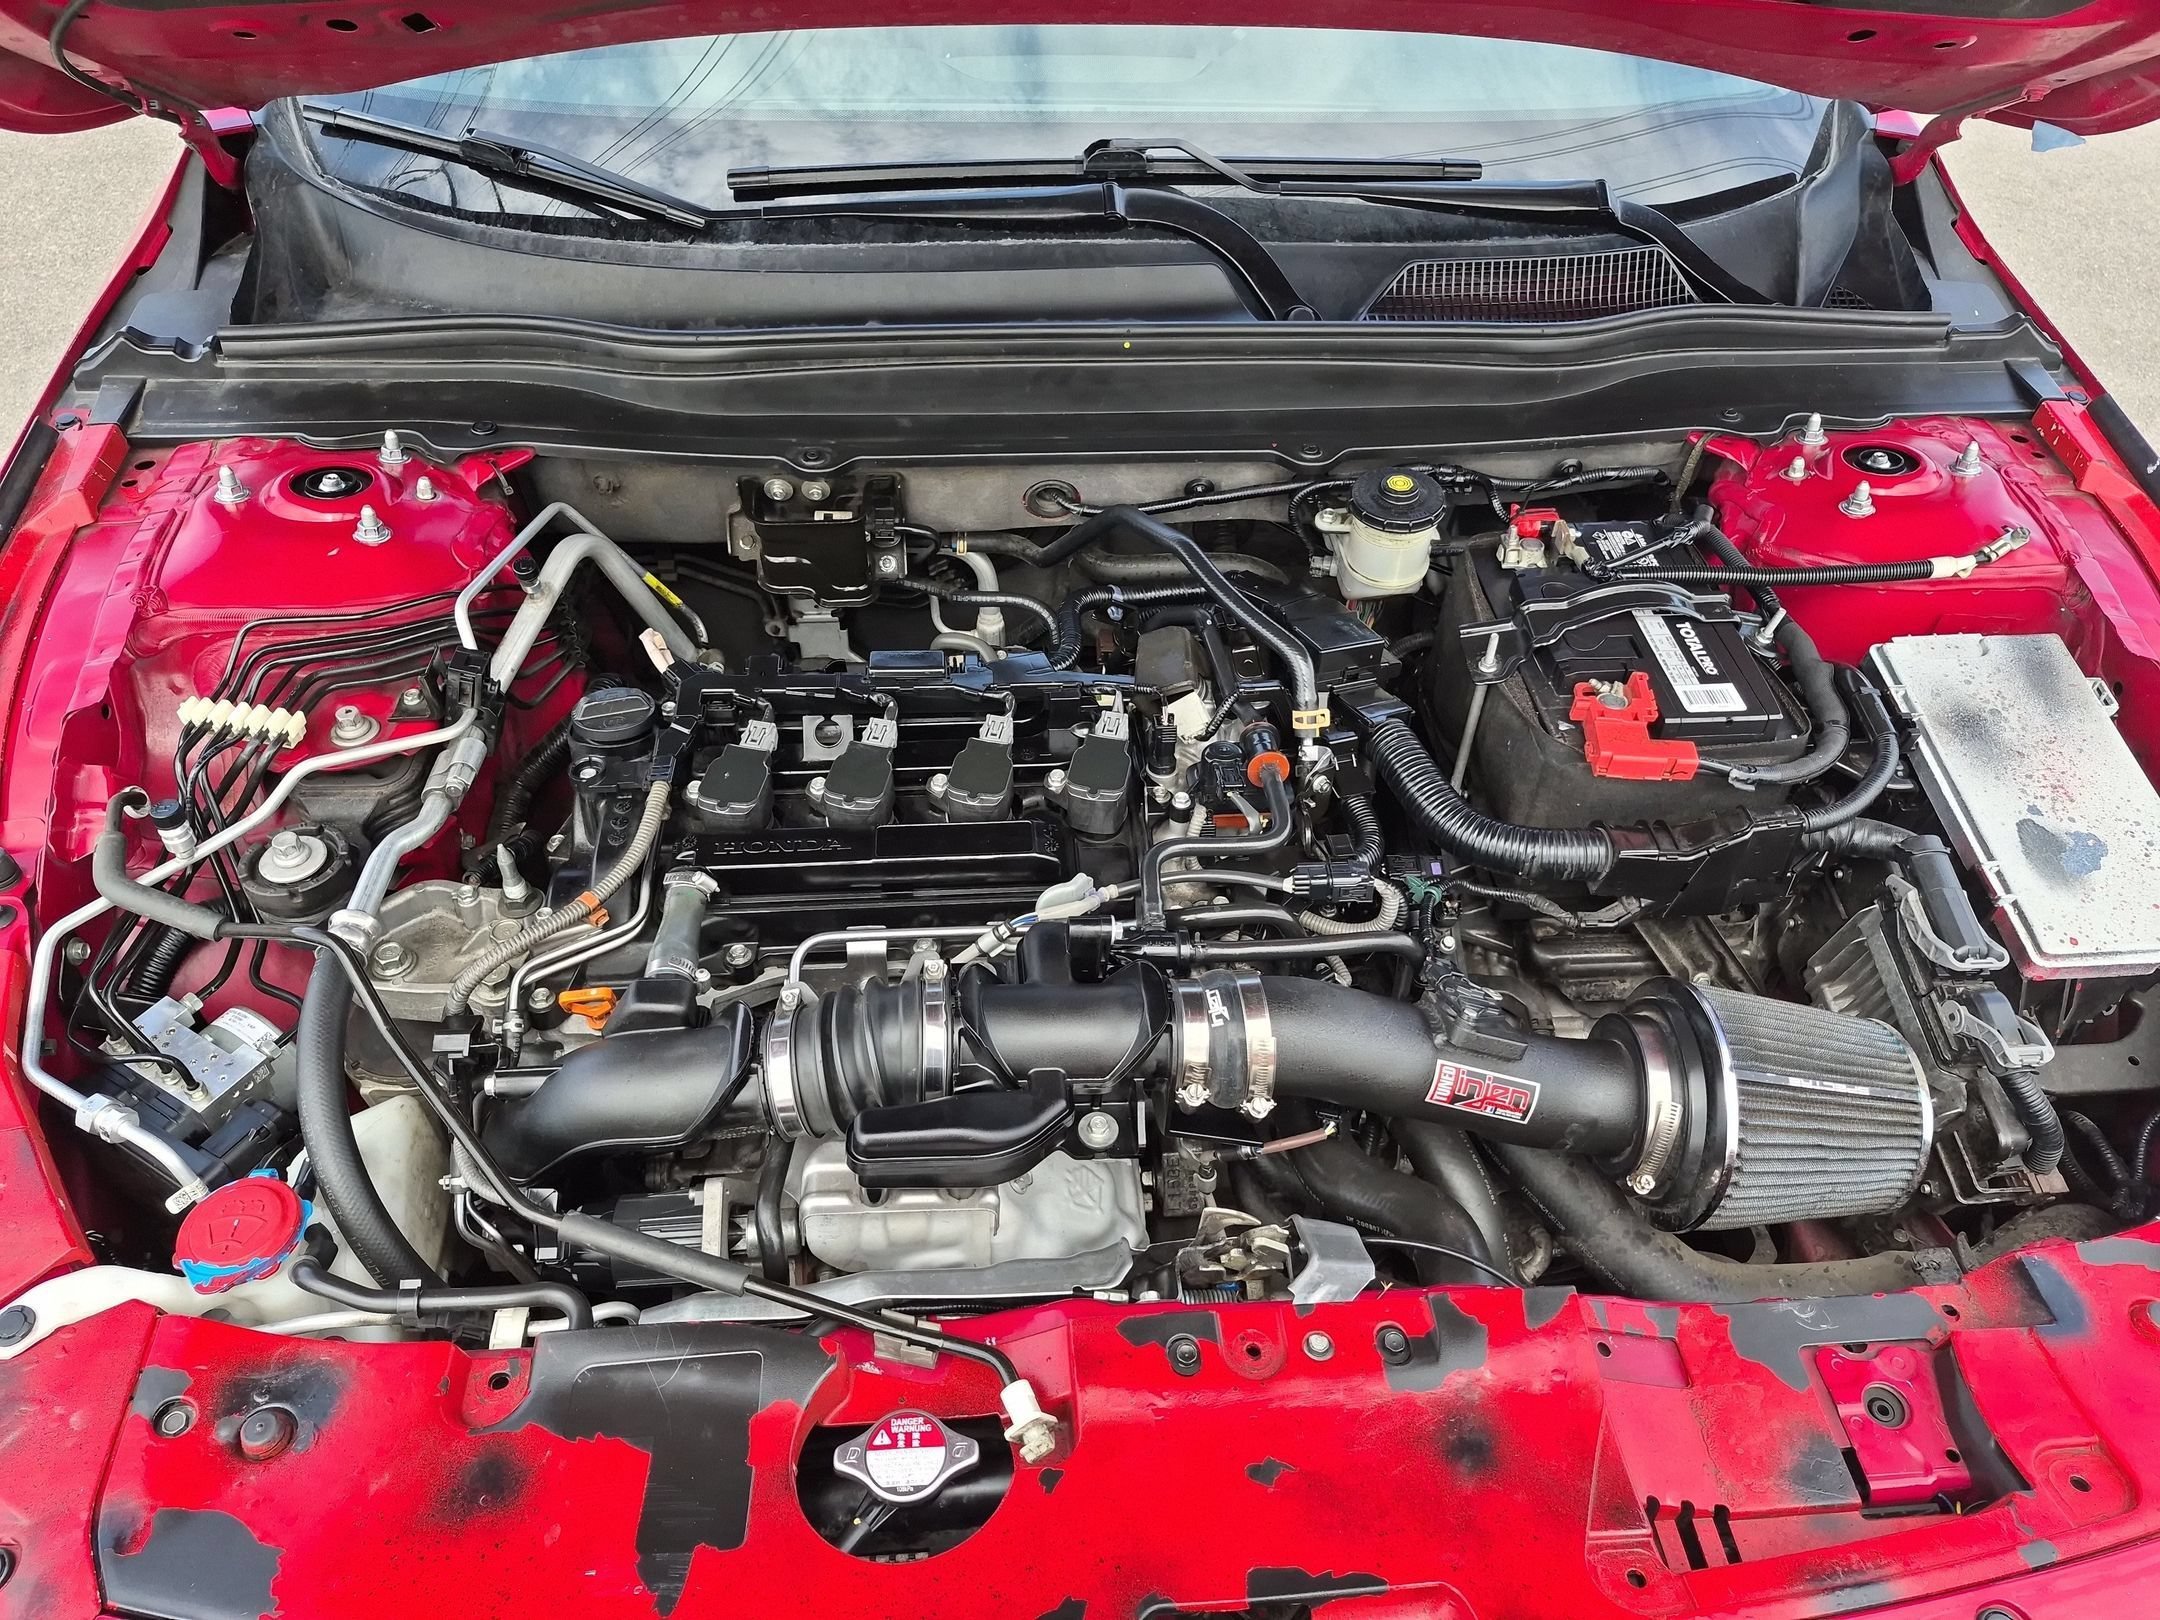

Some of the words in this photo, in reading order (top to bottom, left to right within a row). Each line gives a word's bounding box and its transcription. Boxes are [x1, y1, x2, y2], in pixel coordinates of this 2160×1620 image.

[1675, 621, 1719, 677] TOTALPRO
[713, 839, 851, 855] HONDA
[1434, 1065, 1457, 1101] TUNED
[1454, 1068, 1530, 1111] injen
[891, 1417, 924, 1426] DANGER
[891, 1424, 932, 1433] WARNUNG
